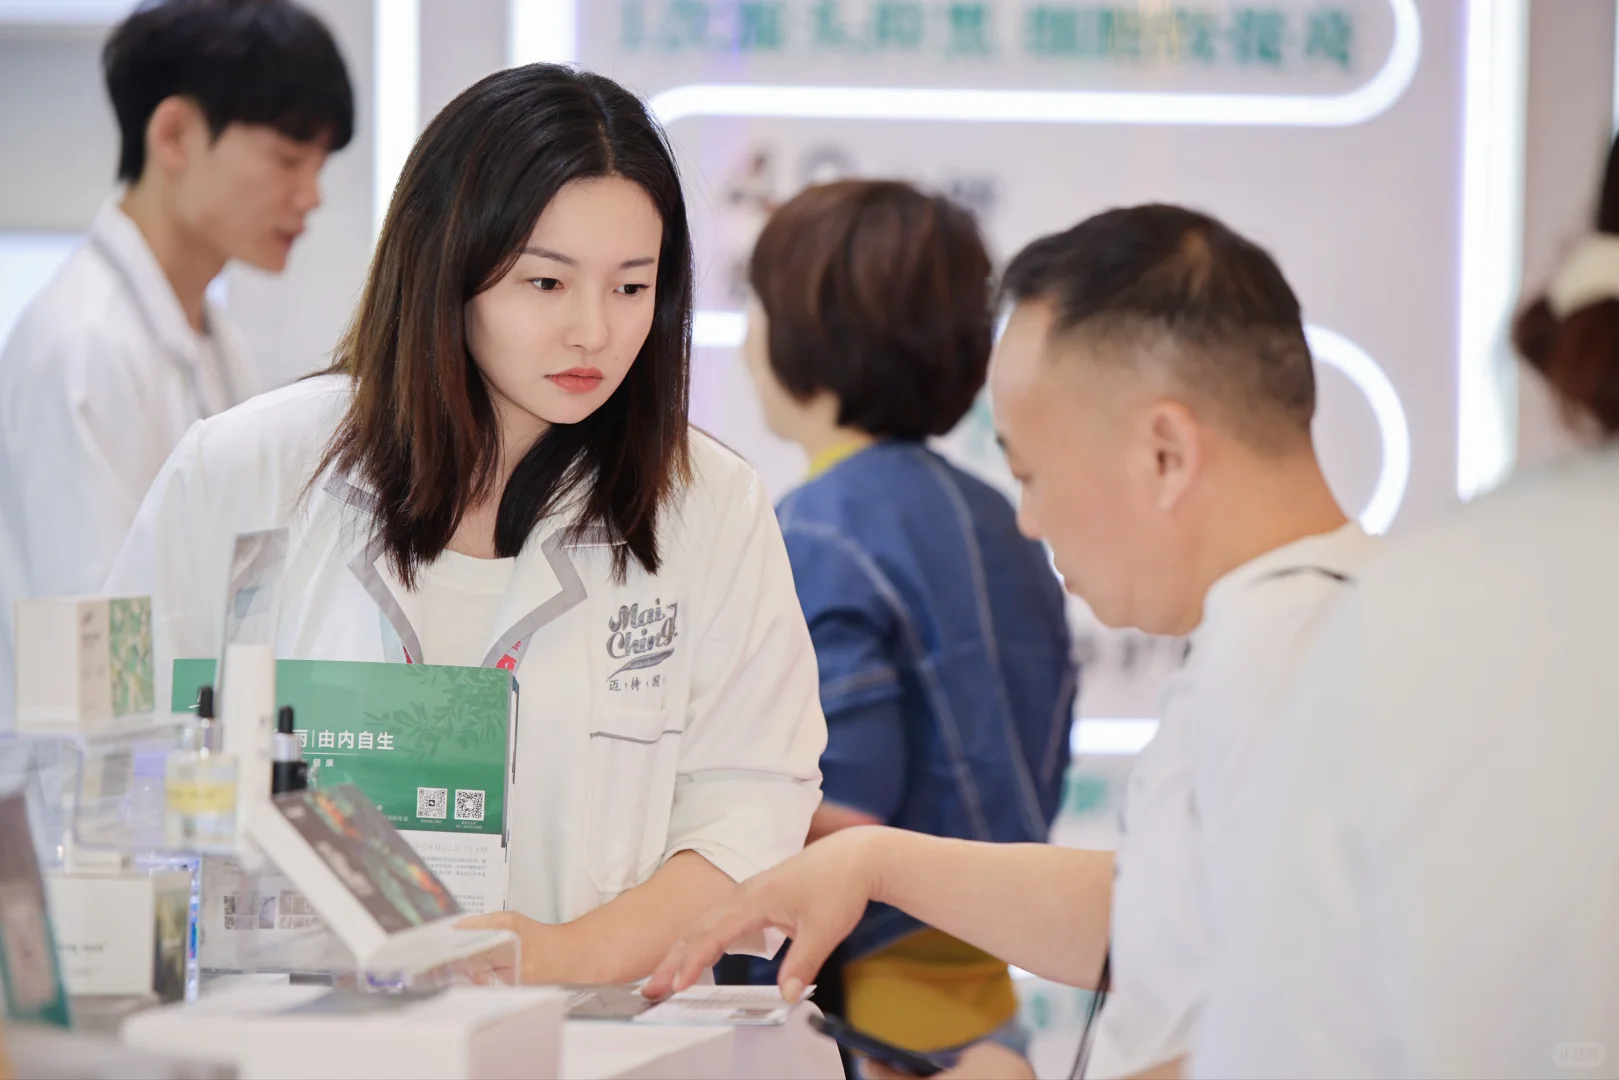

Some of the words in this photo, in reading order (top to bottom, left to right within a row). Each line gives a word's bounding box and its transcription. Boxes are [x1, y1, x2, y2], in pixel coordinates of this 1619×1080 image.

[608, 597, 667, 633] Mai
[318, 729, 395, 750] 由内自生
[464, 845, 488, 854] TEAM
